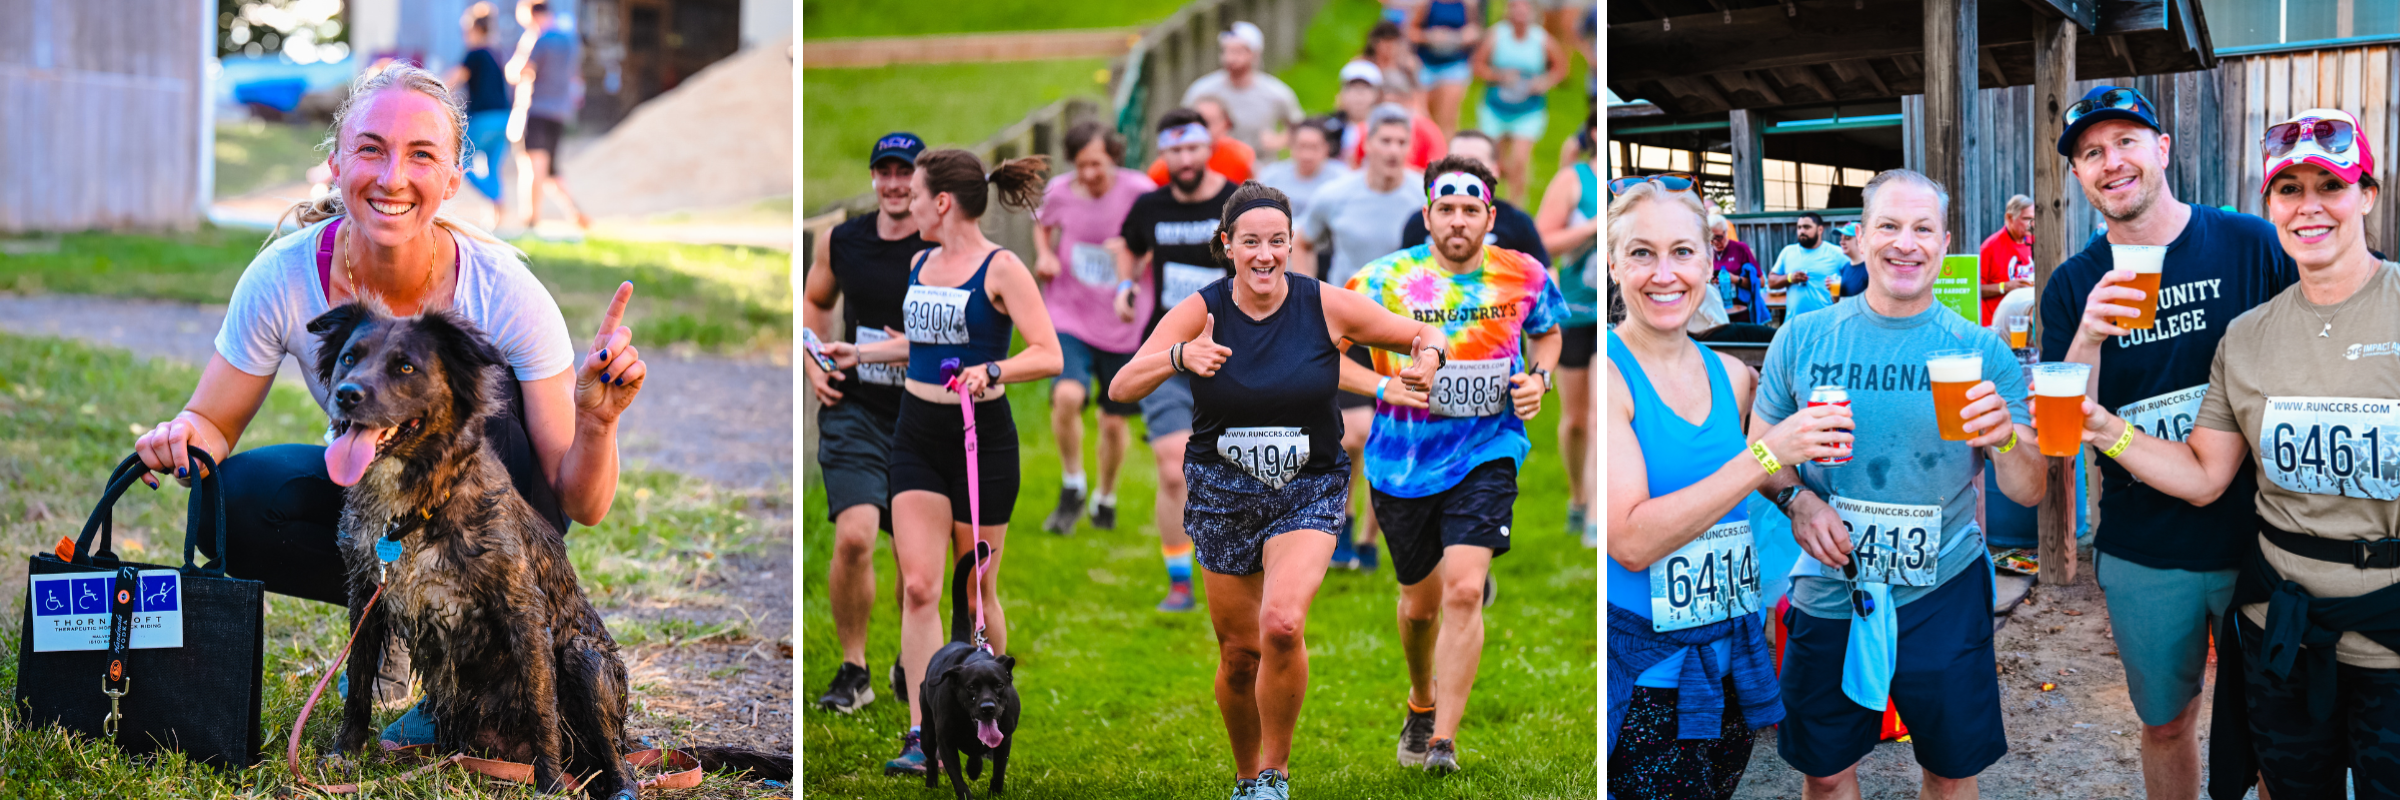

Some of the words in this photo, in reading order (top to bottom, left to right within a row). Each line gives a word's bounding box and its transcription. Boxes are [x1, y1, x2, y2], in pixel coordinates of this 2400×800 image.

[908, 301, 956, 331] 3907
[1438, 375, 1501, 405] 3985
[1847, 364, 1932, 392] RAGNA
[2123, 388, 2207, 418] WWW.RUNCCRS.CO
[2274, 401, 2390, 414] WWW.RUNCCRS.COM
[1227, 444, 1300, 477] 3194
[2274, 422, 2380, 479] 6461
[1836, 501, 1934, 518] WWW.RUNCCRS.COM
[1842, 520, 1927, 570] 413
[1666, 545, 1755, 609] 6414
[54, 616, 162, 627] THORNOFT
[120, 620, 128, 649] VODKA
